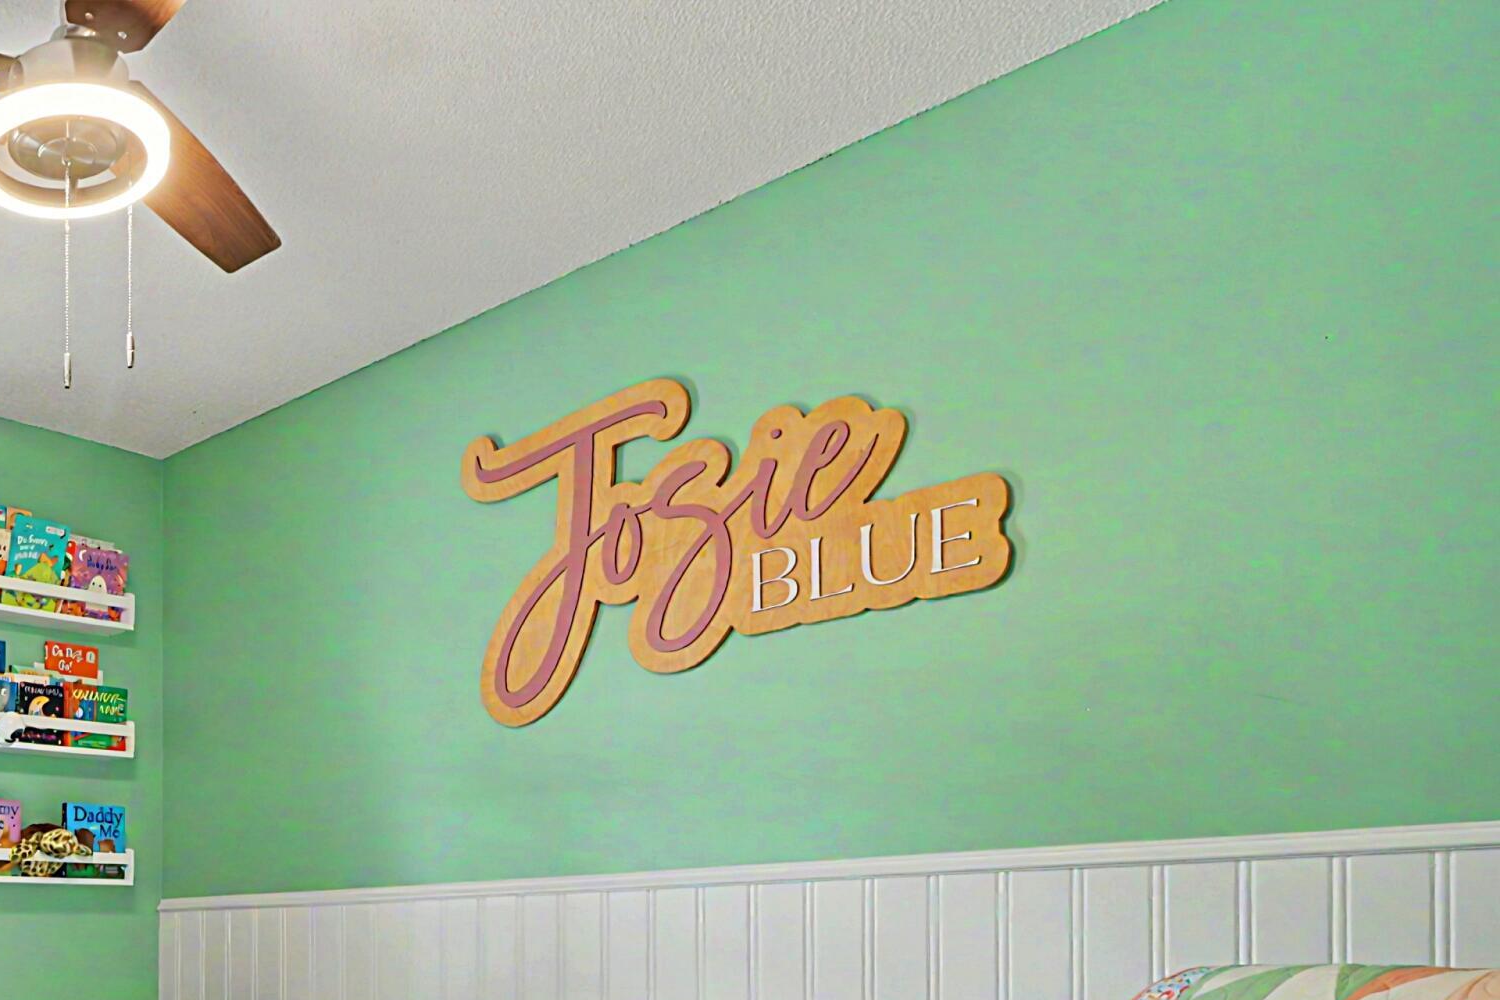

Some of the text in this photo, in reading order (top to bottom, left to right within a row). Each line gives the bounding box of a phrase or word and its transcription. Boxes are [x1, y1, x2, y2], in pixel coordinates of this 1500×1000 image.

[476, 400, 880, 709] Josie
[750, 497, 982, 614] BLUE
[73, 805, 124, 829] Daddy
[99, 824, 120, 839] Me
